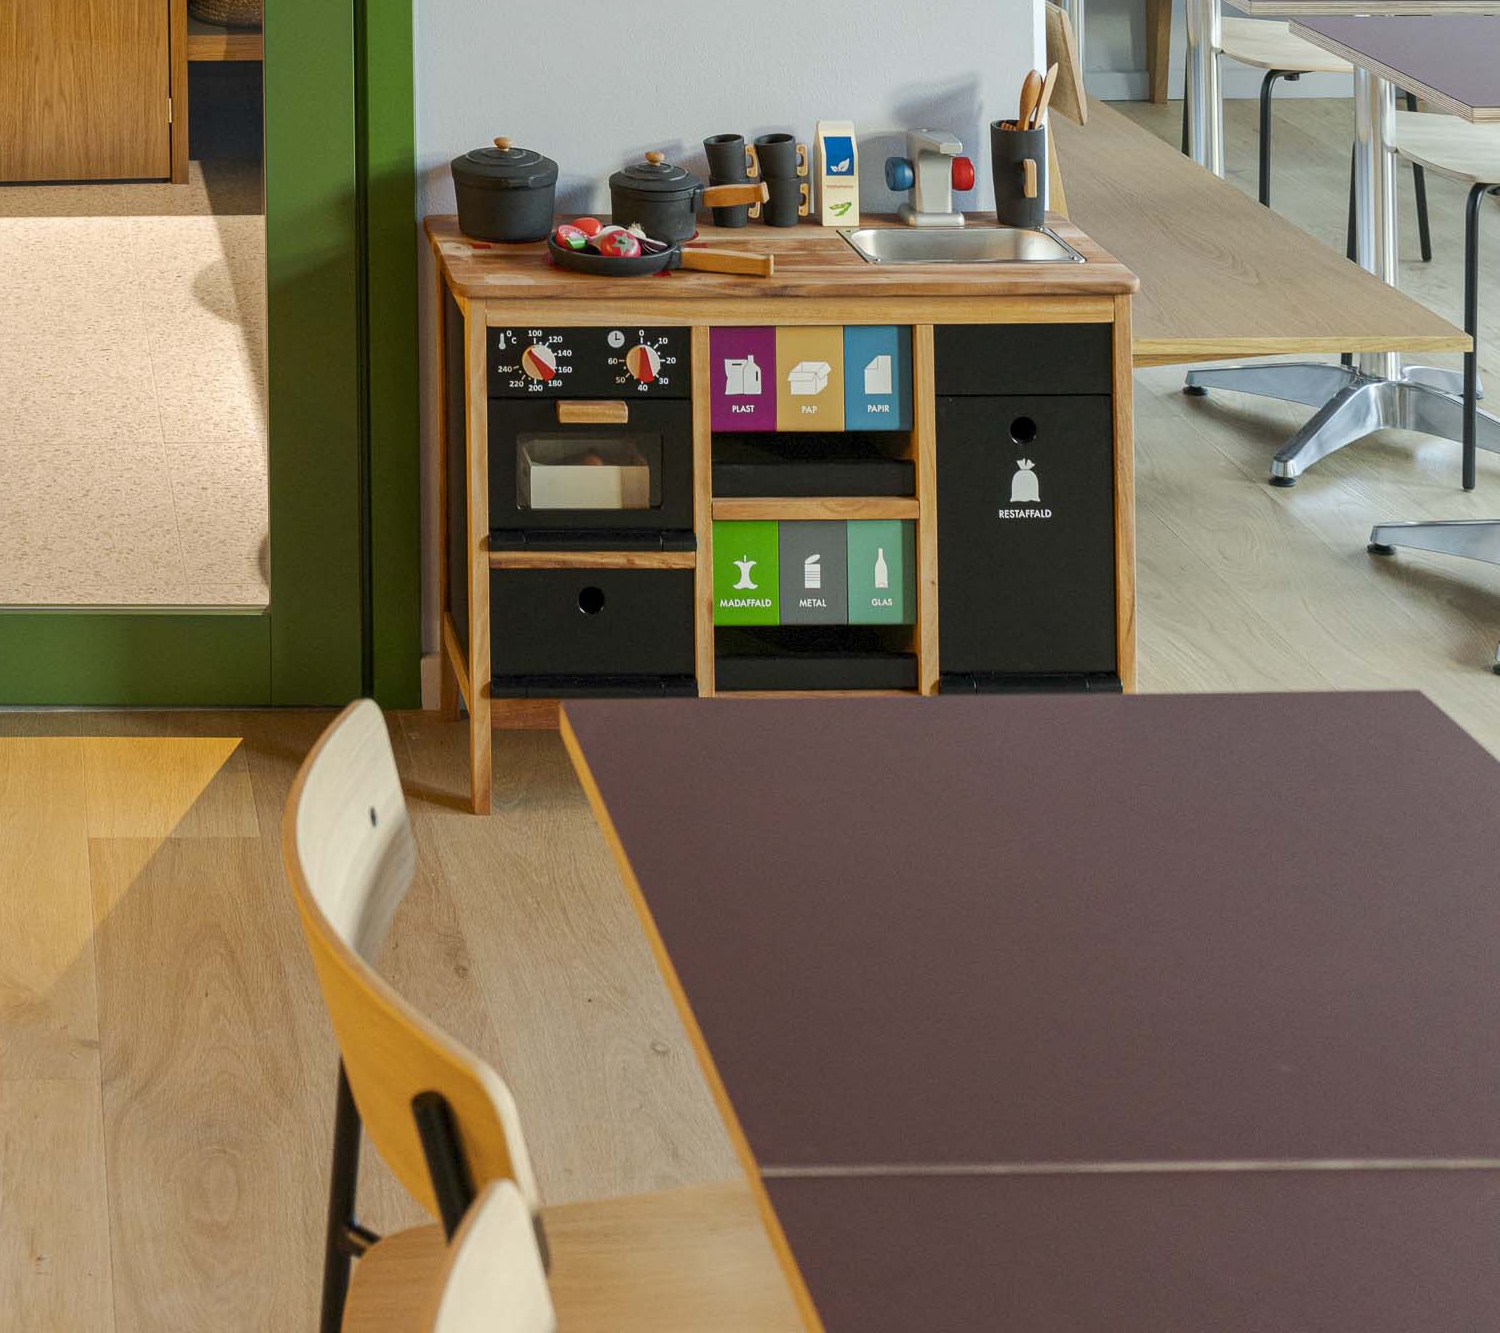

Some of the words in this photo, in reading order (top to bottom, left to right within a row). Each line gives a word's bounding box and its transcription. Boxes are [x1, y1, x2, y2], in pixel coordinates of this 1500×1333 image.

[639, 329, 645, 337] 0
[615, 376, 626, 384] 50
[528, 384, 543, 392] 200
[638, 384, 648, 392] 40
[732, 405, 755, 413] PLAST
[801, 405, 817, 414] PAP
[867, 404, 890, 413] PAPIR
[998, 509, 1052, 518] RESTAFFALD
[719, 598, 772, 608] MADAFFALD
[799, 599, 827, 607] METAL
[871, 598, 893, 606] GLAS
